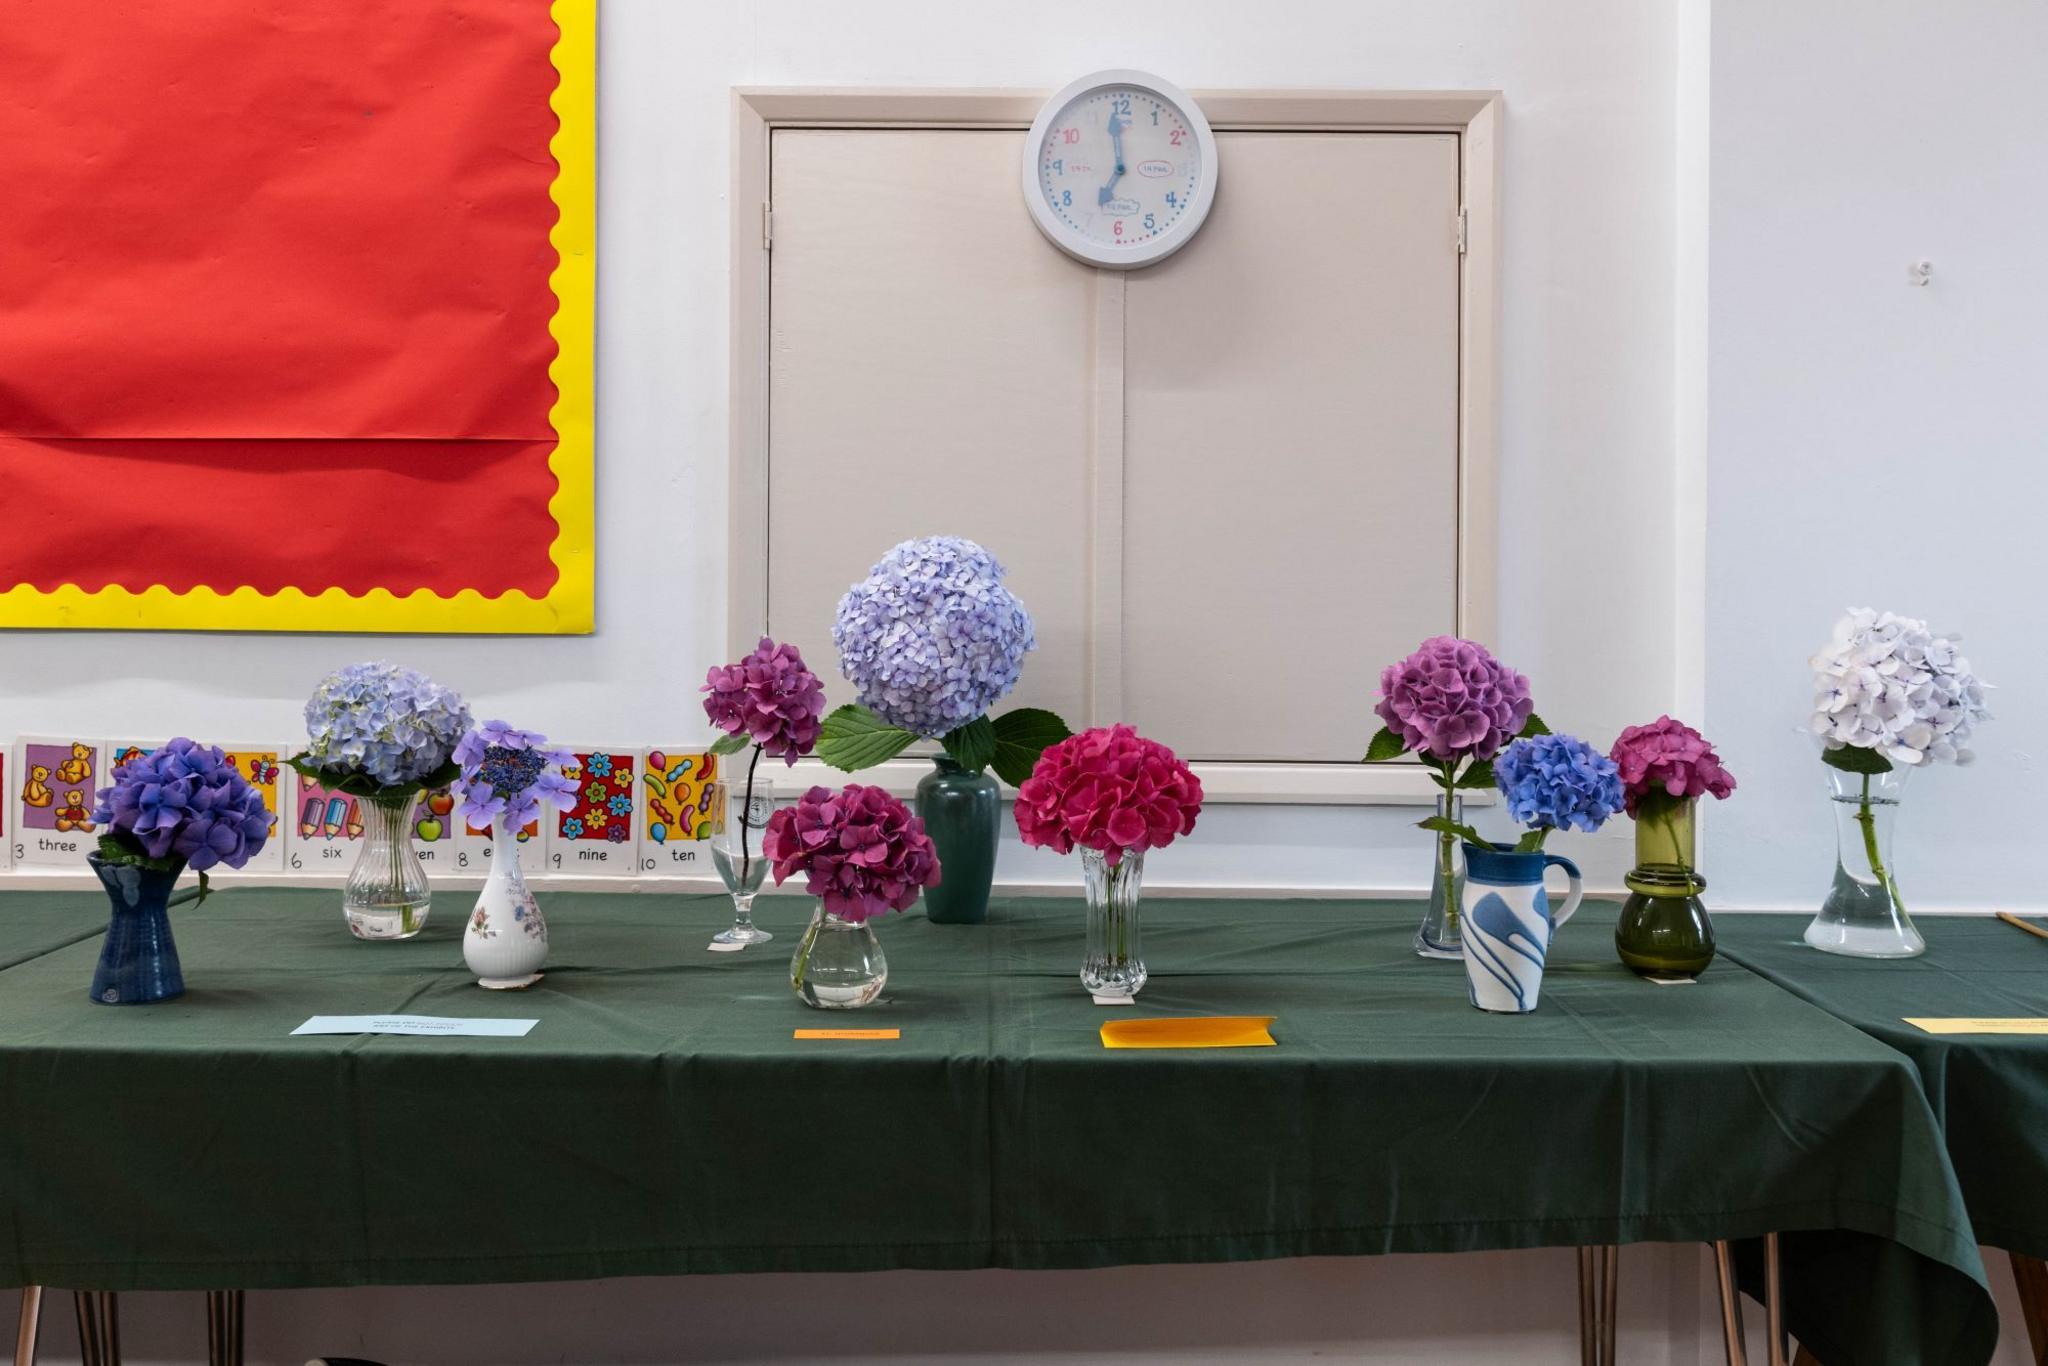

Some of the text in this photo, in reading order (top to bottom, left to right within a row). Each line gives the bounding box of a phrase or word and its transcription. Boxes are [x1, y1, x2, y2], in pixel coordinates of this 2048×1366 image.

[1112, 99, 1132, 115] 12
[1151, 111, 1159, 126] 1
[1063, 128, 1080, 145] 10
[1169, 130, 1182, 146] 2
[1052, 159, 1063, 176] 9
[1062, 190, 1072, 207] 8
[1165, 191, 1177, 208] 4
[1113, 221, 1123, 236] 6
[1143, 213, 1155, 230] 5
[15, 843, 25, 859] 3
[38, 838, 77, 852] three
[321, 846, 342, 859] six
[290, 852, 303, 869] 6
[457, 852, 469, 867] 8
[552, 853, 562, 869] 9
[578, 849, 608, 862] nine
[640, 856, 656, 871] 10
[671, 849, 696, 862] ten
